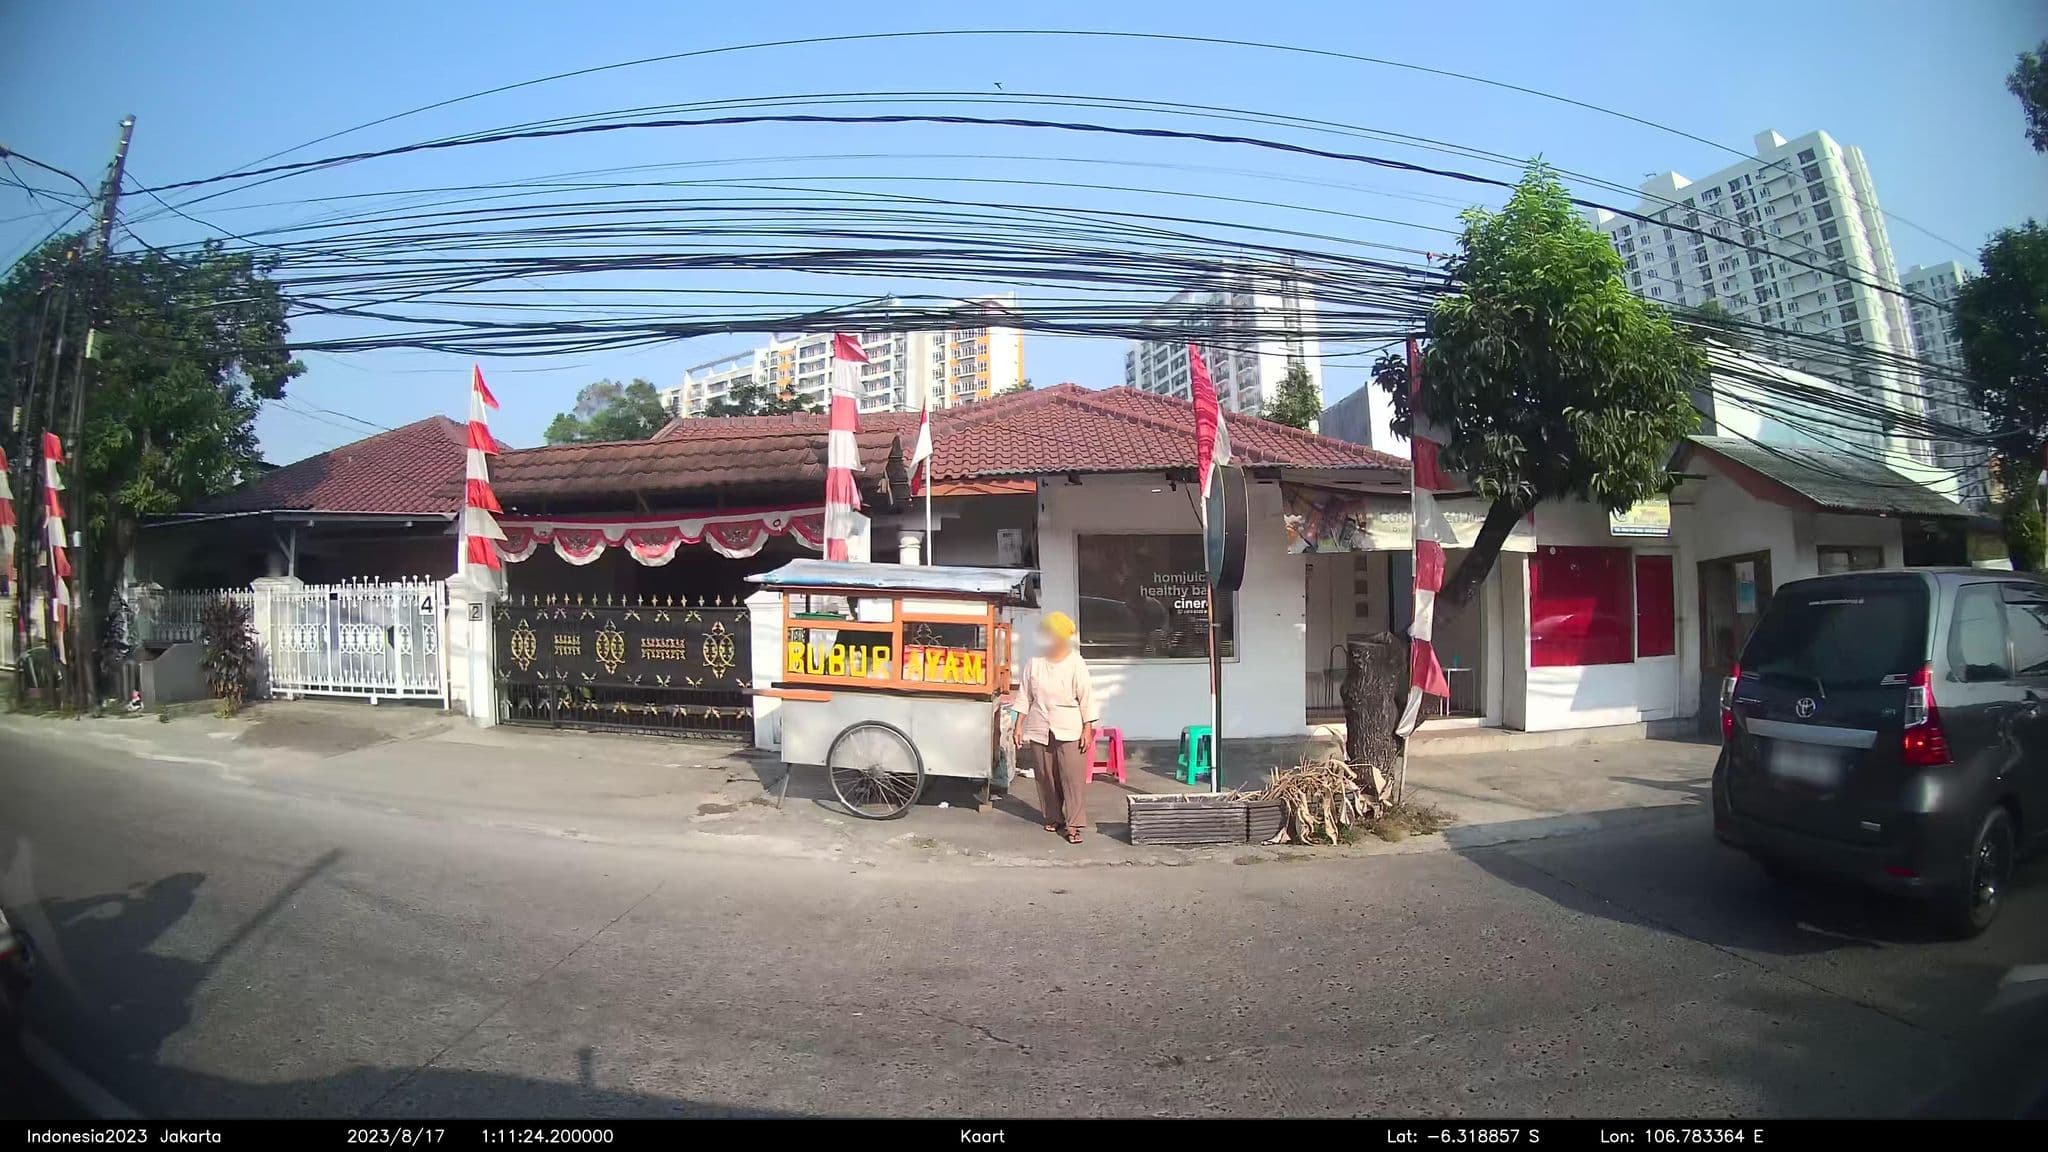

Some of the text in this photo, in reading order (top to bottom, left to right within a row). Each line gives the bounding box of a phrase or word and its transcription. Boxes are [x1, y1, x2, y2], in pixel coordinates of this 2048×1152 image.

[1153, 571, 1206, 584] homjuic
[1140, 585, 1208, 597] healthy ba
[421, 596, 433, 613] 4
[1174, 598, 1208, 609] ciner
[472, 606, 480, 618] 2
[787, 641, 983, 685] BUBUR AYAM
